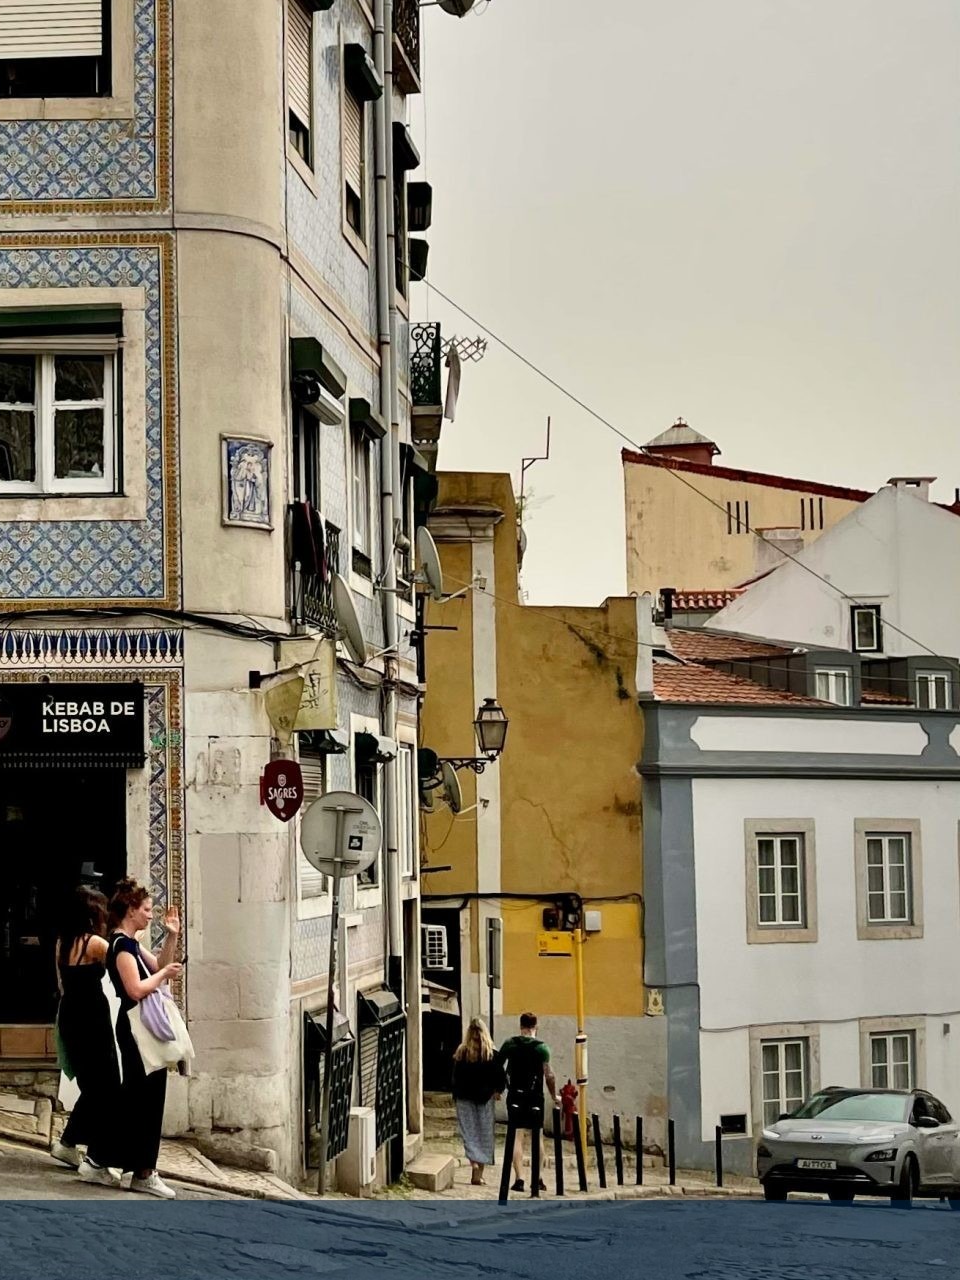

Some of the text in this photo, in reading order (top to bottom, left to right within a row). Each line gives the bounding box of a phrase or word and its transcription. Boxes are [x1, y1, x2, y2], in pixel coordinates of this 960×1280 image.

[42, 701, 135, 716] KEBAB DE
[42, 718, 111, 733] LISBOA
[268, 786, 298, 800] SAGRES
